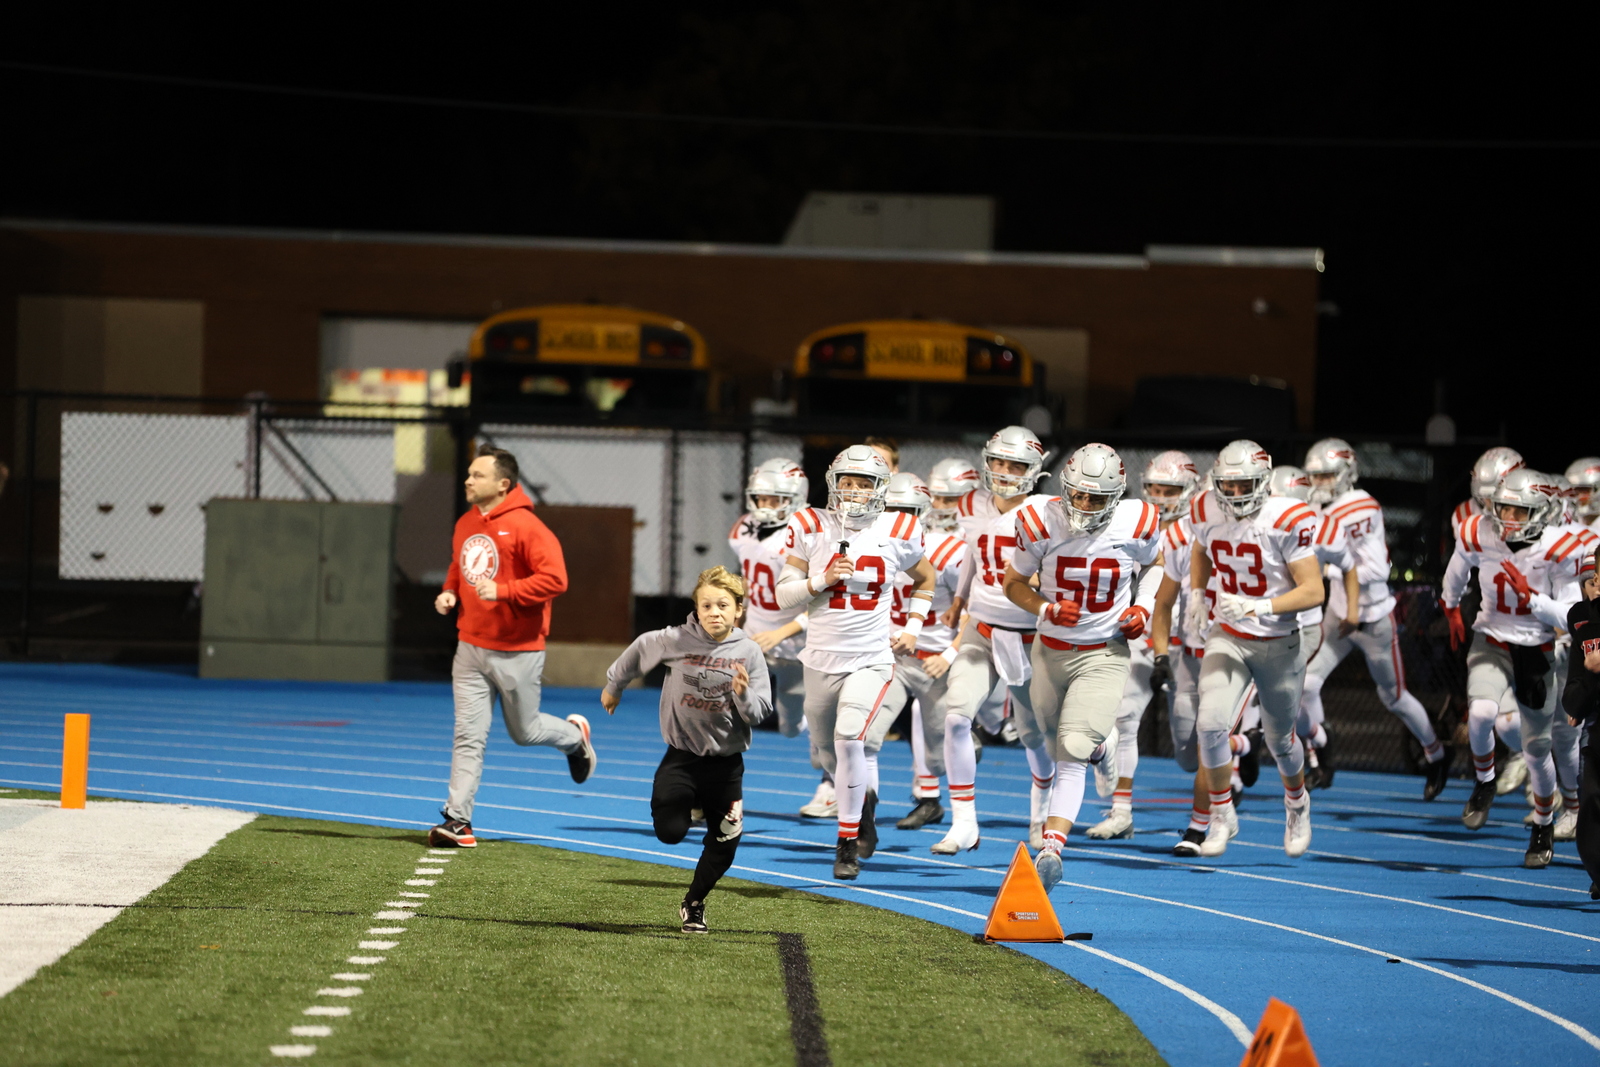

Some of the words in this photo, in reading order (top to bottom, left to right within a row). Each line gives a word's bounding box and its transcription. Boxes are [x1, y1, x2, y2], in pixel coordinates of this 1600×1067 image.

[743, 558, 781, 611] 10
[1055, 555, 1120, 614] 50
[1211, 539, 1268, 597] 63
